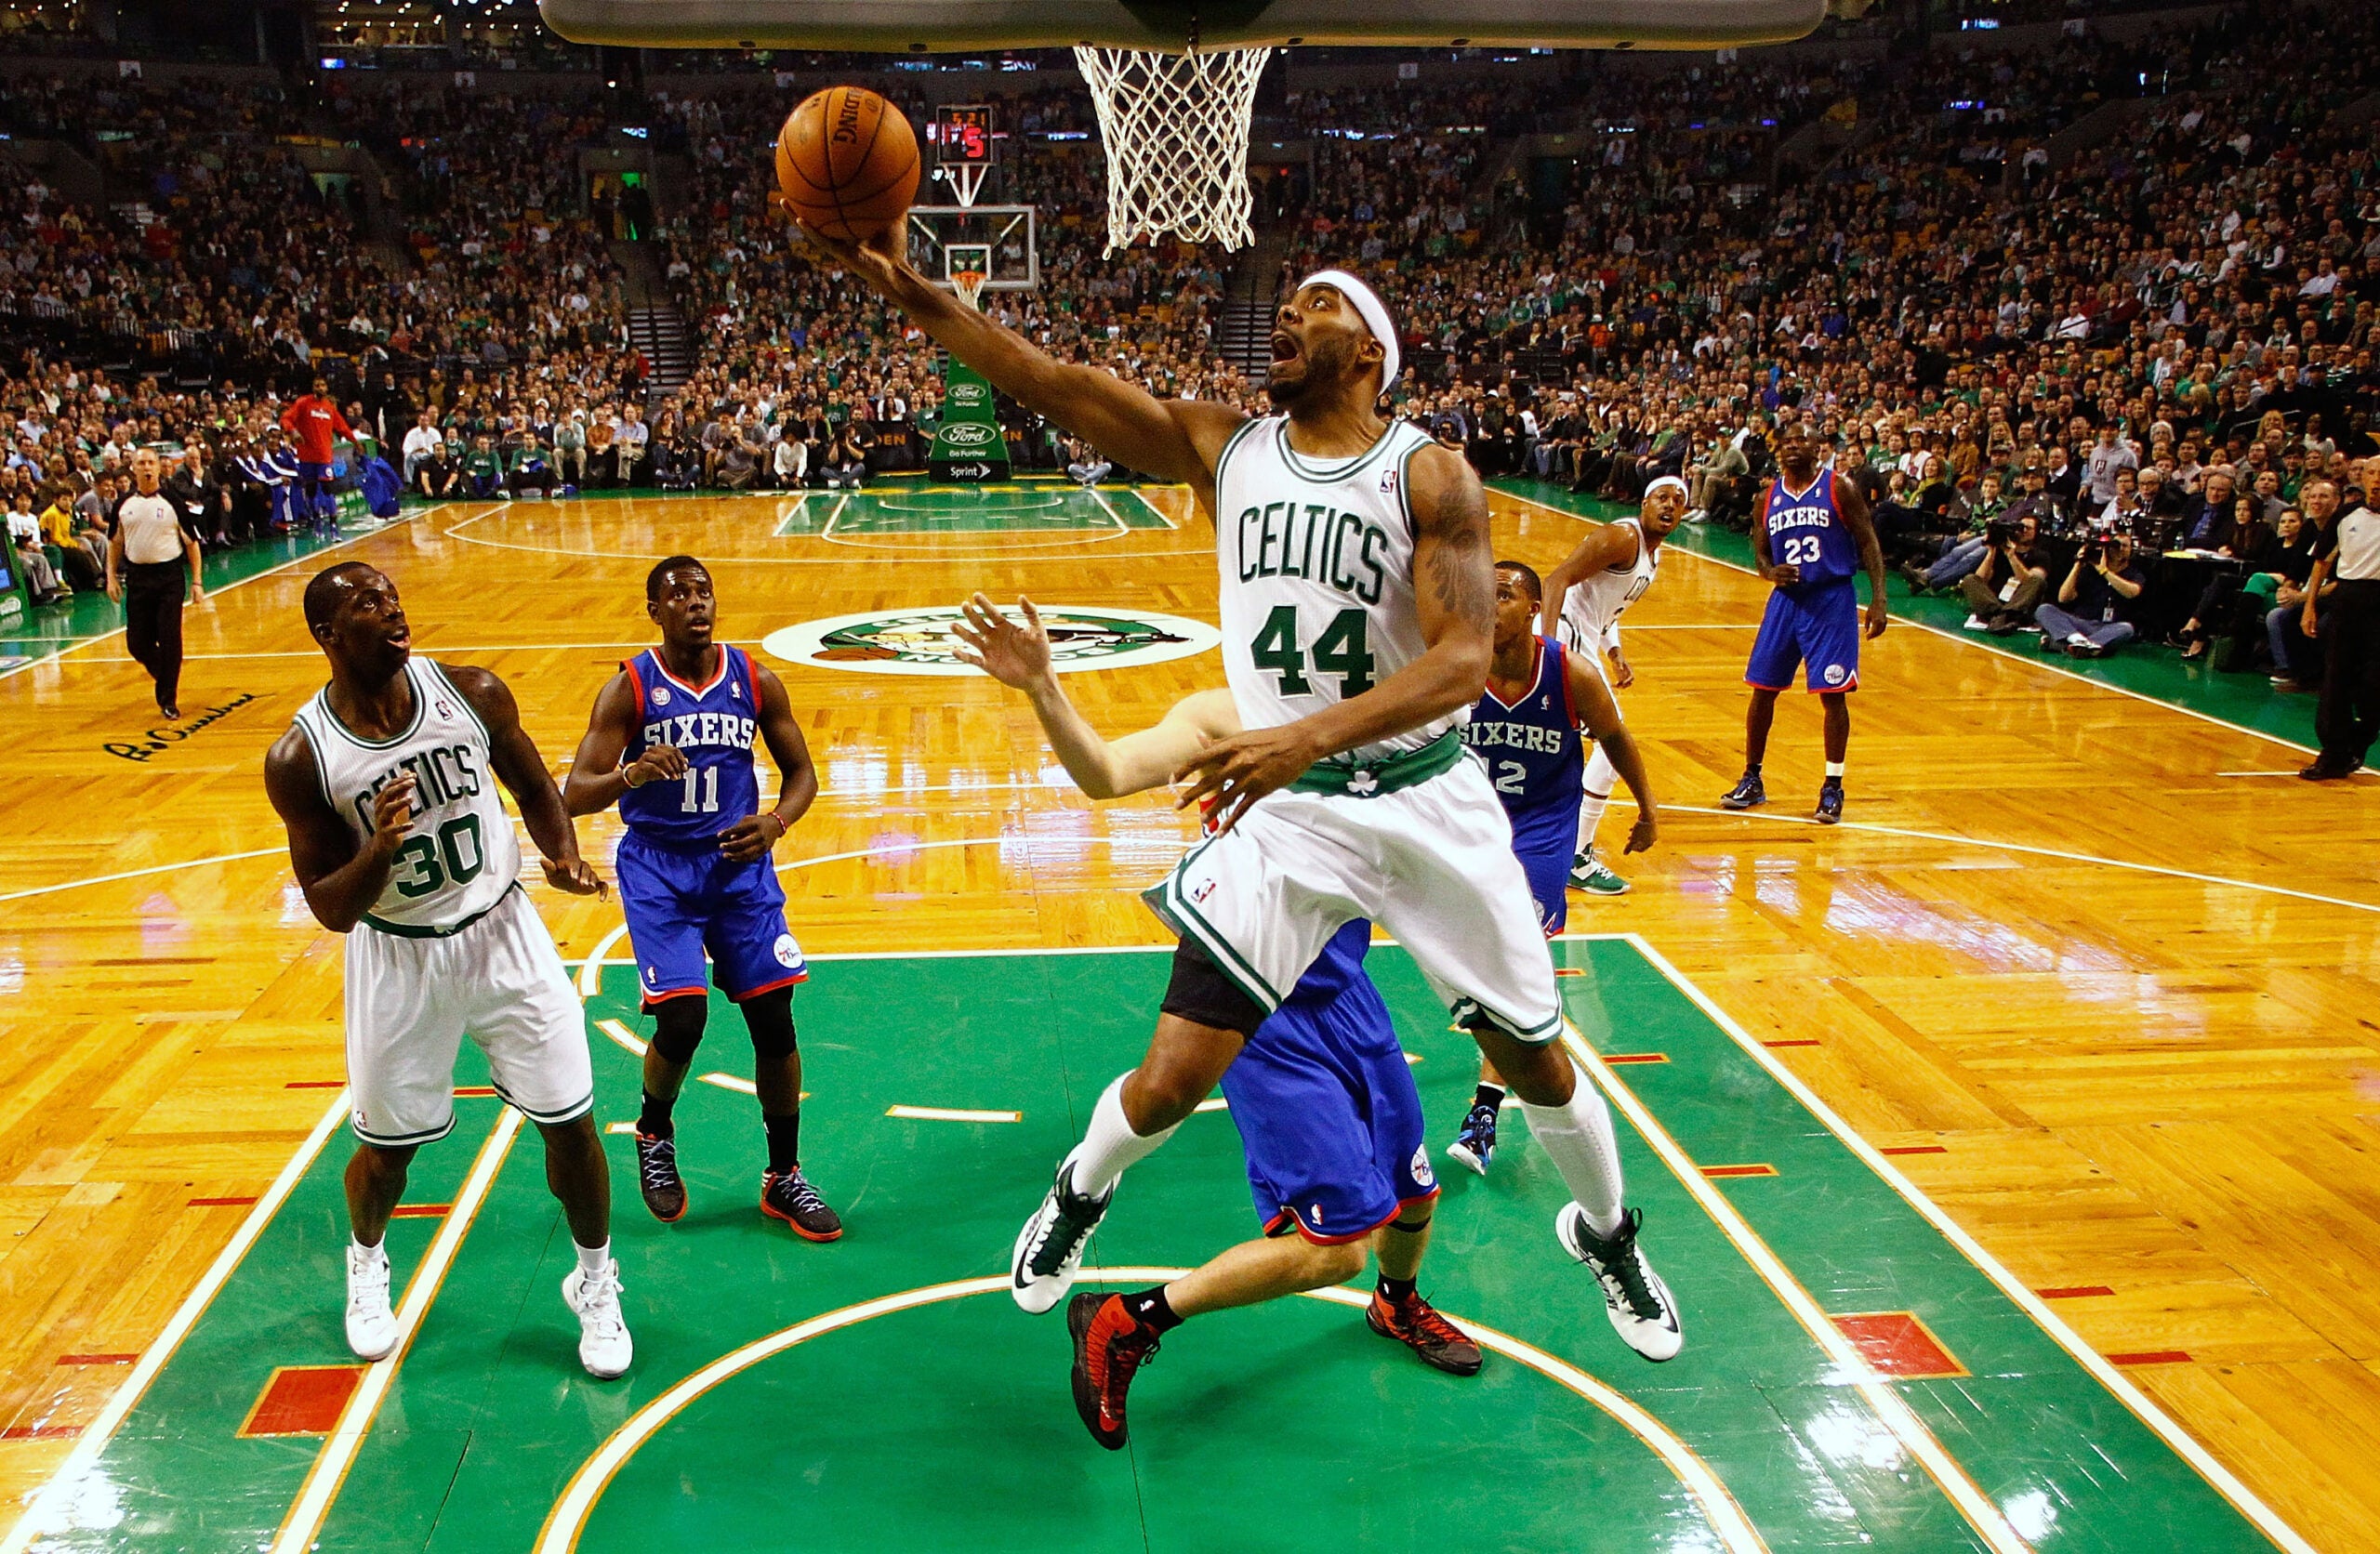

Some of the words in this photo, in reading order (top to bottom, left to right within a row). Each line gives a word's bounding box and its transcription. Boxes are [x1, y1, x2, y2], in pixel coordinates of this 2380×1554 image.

[955, 387, 979, 398] Ford
[948, 427, 985, 442] Ford
[948, 449, 959, 457] Go
[960, 449, 986, 457] Further
[950, 467, 977, 479] Sprint
[1768, 507, 1830, 535] SIXERS
[1239, 501, 1388, 606] CELTICS
[1784, 535, 1820, 565] 23
[1250, 605, 1376, 700] 44
[644, 712, 754, 750] SIXERS
[1457, 722, 1562, 755] SIXERS
[354, 744, 480, 836] CTICS
[681, 766, 719, 813] 11
[391, 812, 484, 899] 30
